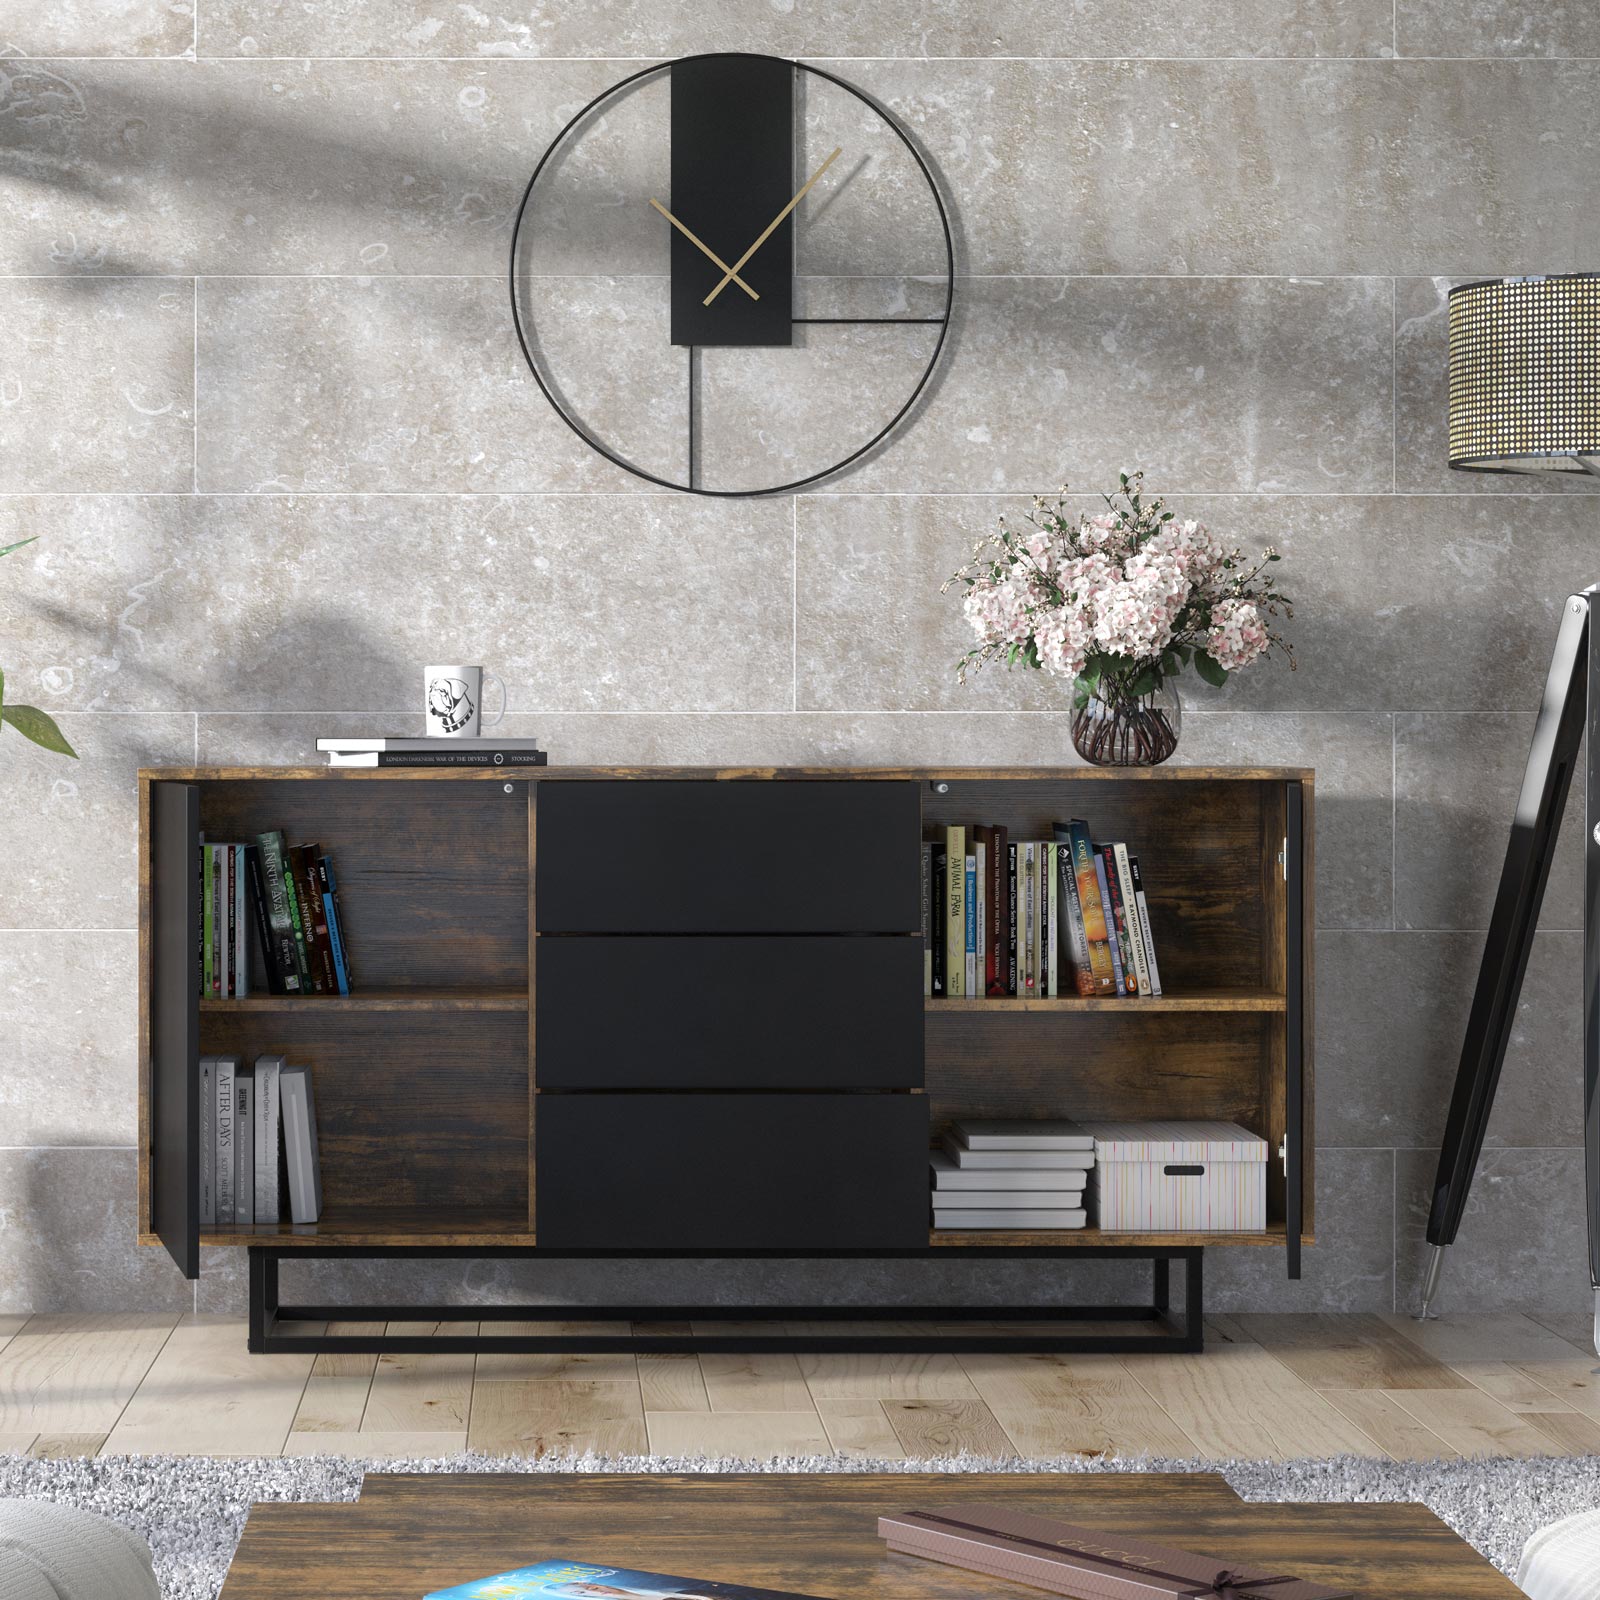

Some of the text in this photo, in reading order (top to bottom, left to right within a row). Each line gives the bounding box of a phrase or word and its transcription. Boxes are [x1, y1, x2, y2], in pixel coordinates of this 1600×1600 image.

[1077, 839, 1090, 873] FORTIFY
[1104, 847, 1113, 860] The
[1065, 864, 1076, 890] SPECIAL
[1105, 862, 1116, 879] Lady
[950, 856, 962, 917] ANIMAL FARM
[1083, 876, 1096, 900] YOUR
[1110, 888, 1120, 899] the
[1124, 877, 1132, 896] SLEEP
[1071, 892, 1080, 913] AGENT
[302, 902, 314, 942] INFERNO
[1075, 915, 1084, 931] NICK
[1078, 932, 1089, 957] TORRES
[1128, 904, 1146, 974] RAYMOND CHANDLER
[1095, 940, 1107, 968] BERGEY
[219, 1074, 231, 1147] AFTER DAYS
[238, 1088, 247, 1111] GREENING
[1057, 1540, 1167, 1566] GUCCI
